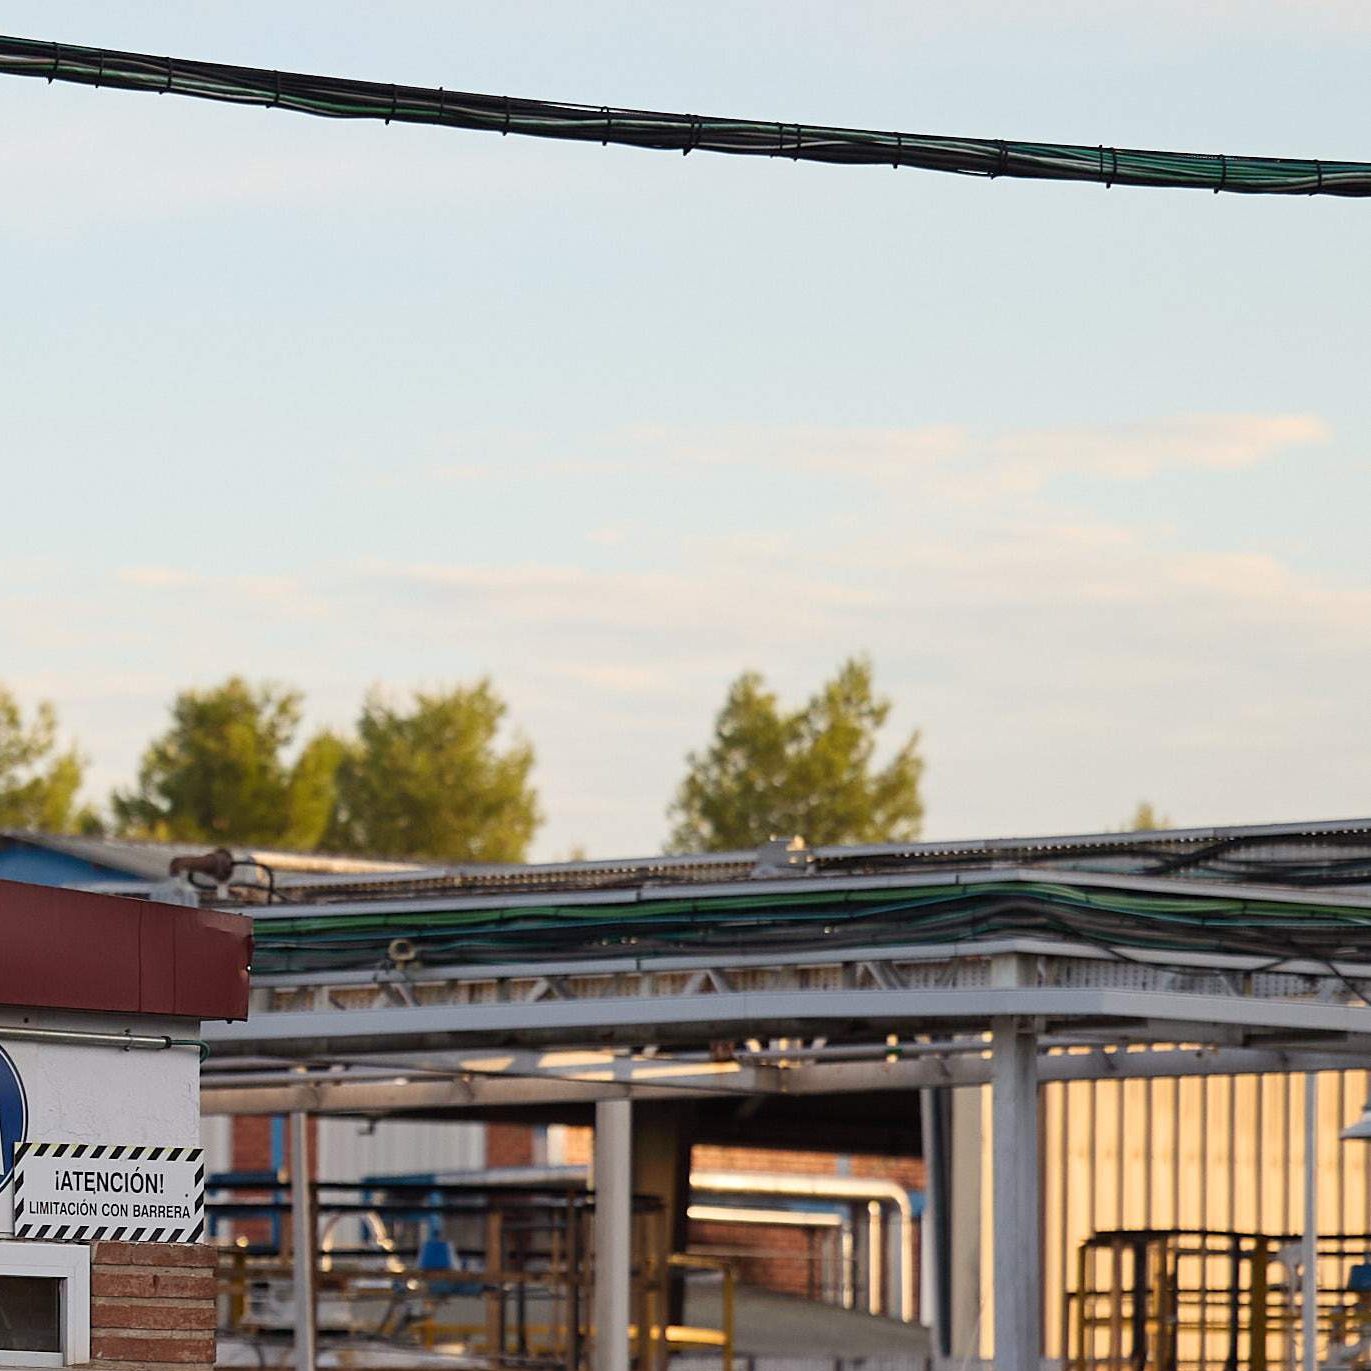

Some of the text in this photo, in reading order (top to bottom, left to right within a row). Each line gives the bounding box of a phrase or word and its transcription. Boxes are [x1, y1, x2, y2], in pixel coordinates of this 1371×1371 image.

[55, 1166, 164, 1194] ¡ATENCIÓN!
[29, 1199, 191, 1219] LIMITACIÓN CON BARRERA
